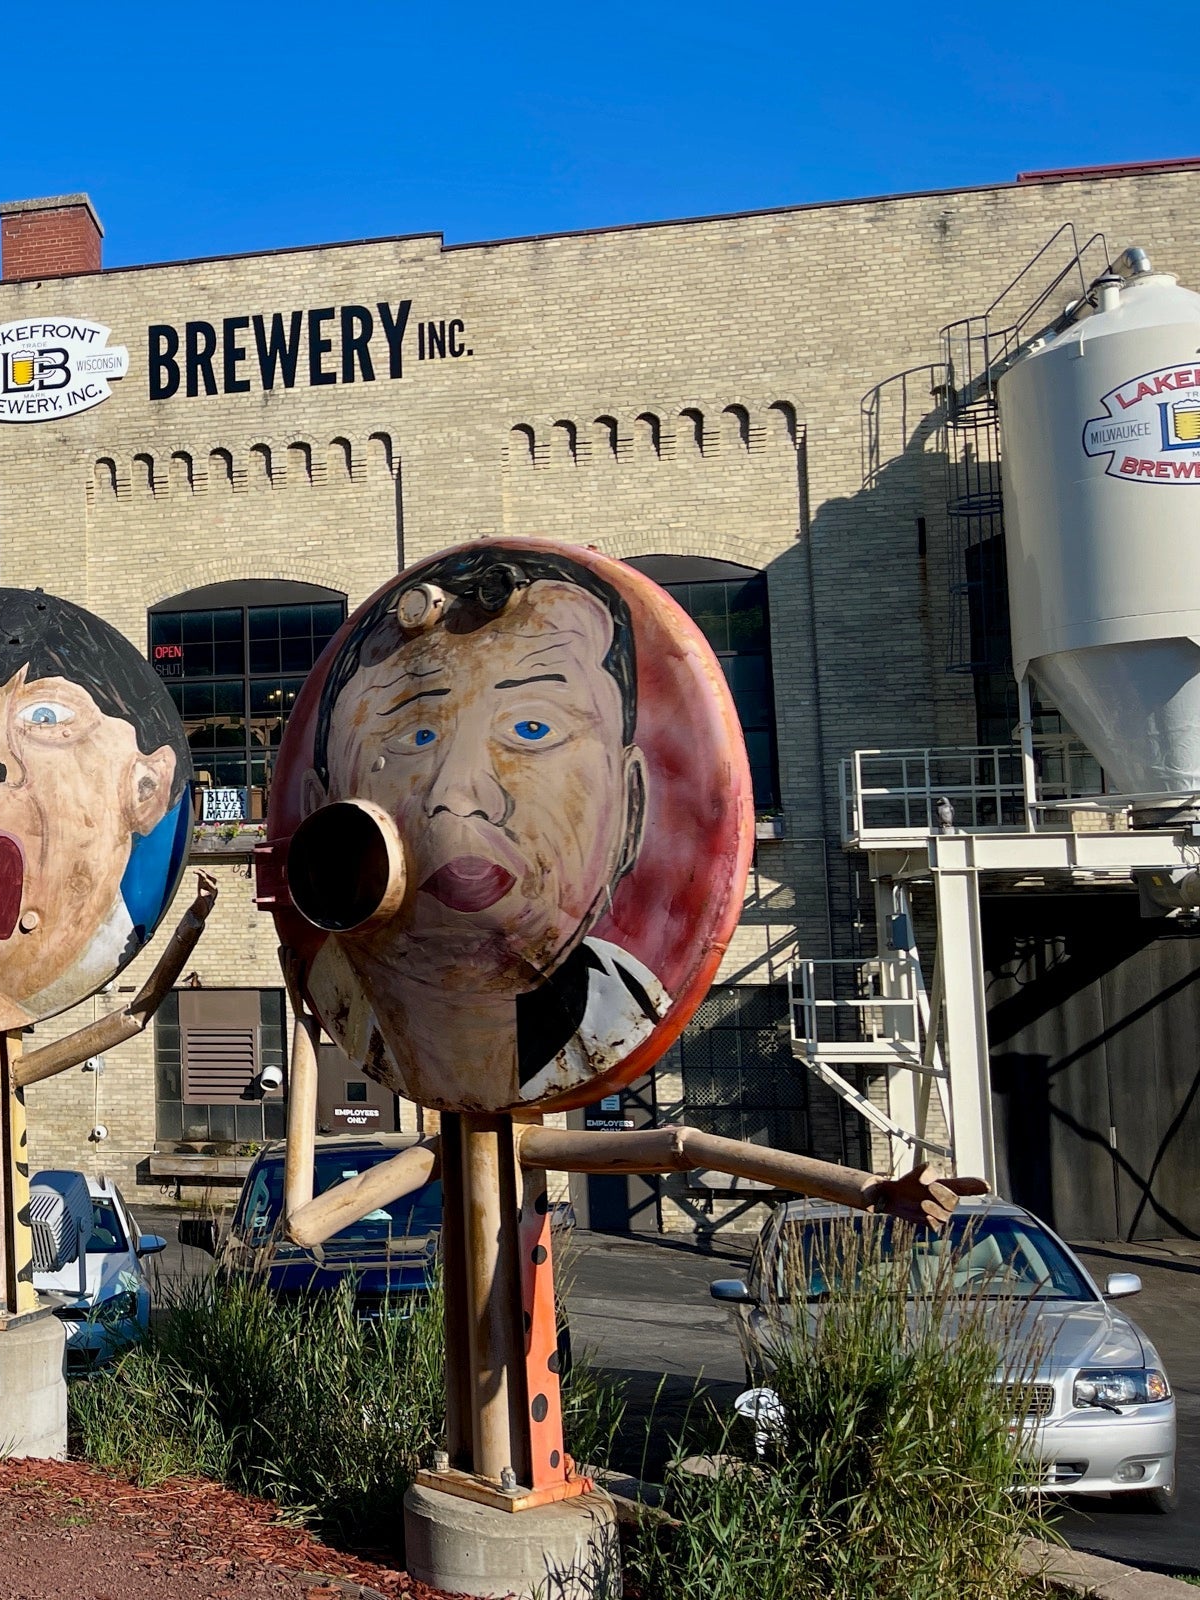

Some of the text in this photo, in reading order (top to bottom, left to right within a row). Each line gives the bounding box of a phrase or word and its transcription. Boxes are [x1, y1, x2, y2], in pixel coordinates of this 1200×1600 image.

[22, 341, 48, 349] TRADE
[148, 300, 413, 401] BREWERY
[417, 318, 474, 361] INC.
[76, 356, 123, 372] WISCONSIN
[66, 384, 103, 406] INC.
[1090, 422, 1151, 445] MILWAUKEE
[155, 645, 182, 659] OPEN
[155, 663, 181, 676] SHUT
[207, 790, 245, 803] BLACK
[207, 802, 245, 810] LIVES
[206, 810, 246, 819] MATTER
[334, 1108, 380, 1117] EMPLOYEES
[586, 1120, 634, 1128] EMPLOYEES
